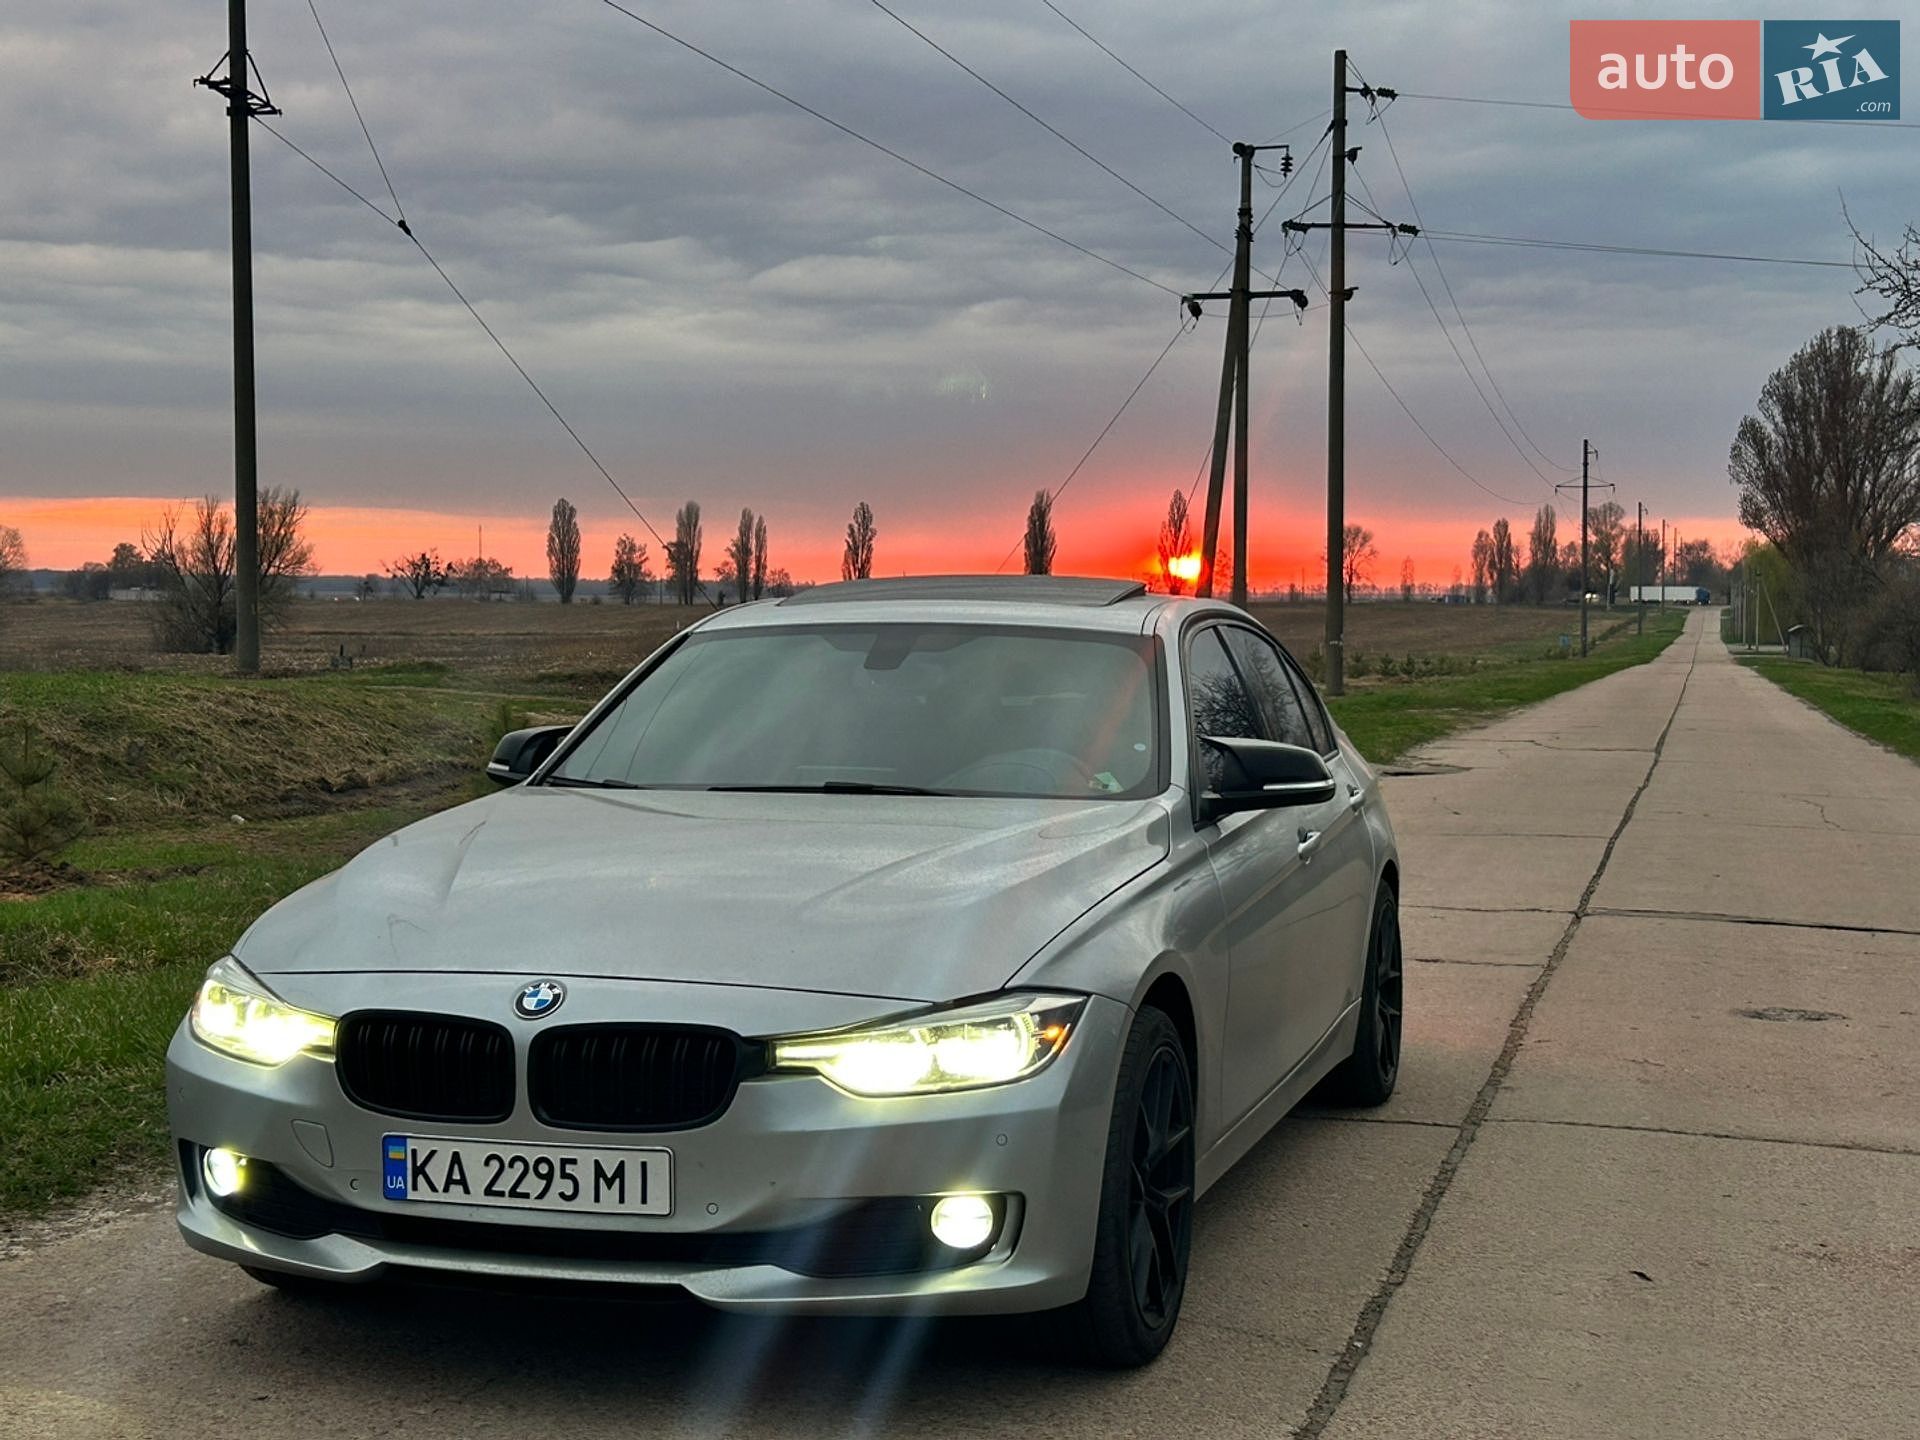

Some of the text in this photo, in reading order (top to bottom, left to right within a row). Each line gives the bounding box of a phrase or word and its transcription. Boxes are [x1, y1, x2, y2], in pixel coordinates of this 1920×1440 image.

[386, 1175, 405, 1190] UA
[410, 1148, 648, 1205] KA 2295 MI
